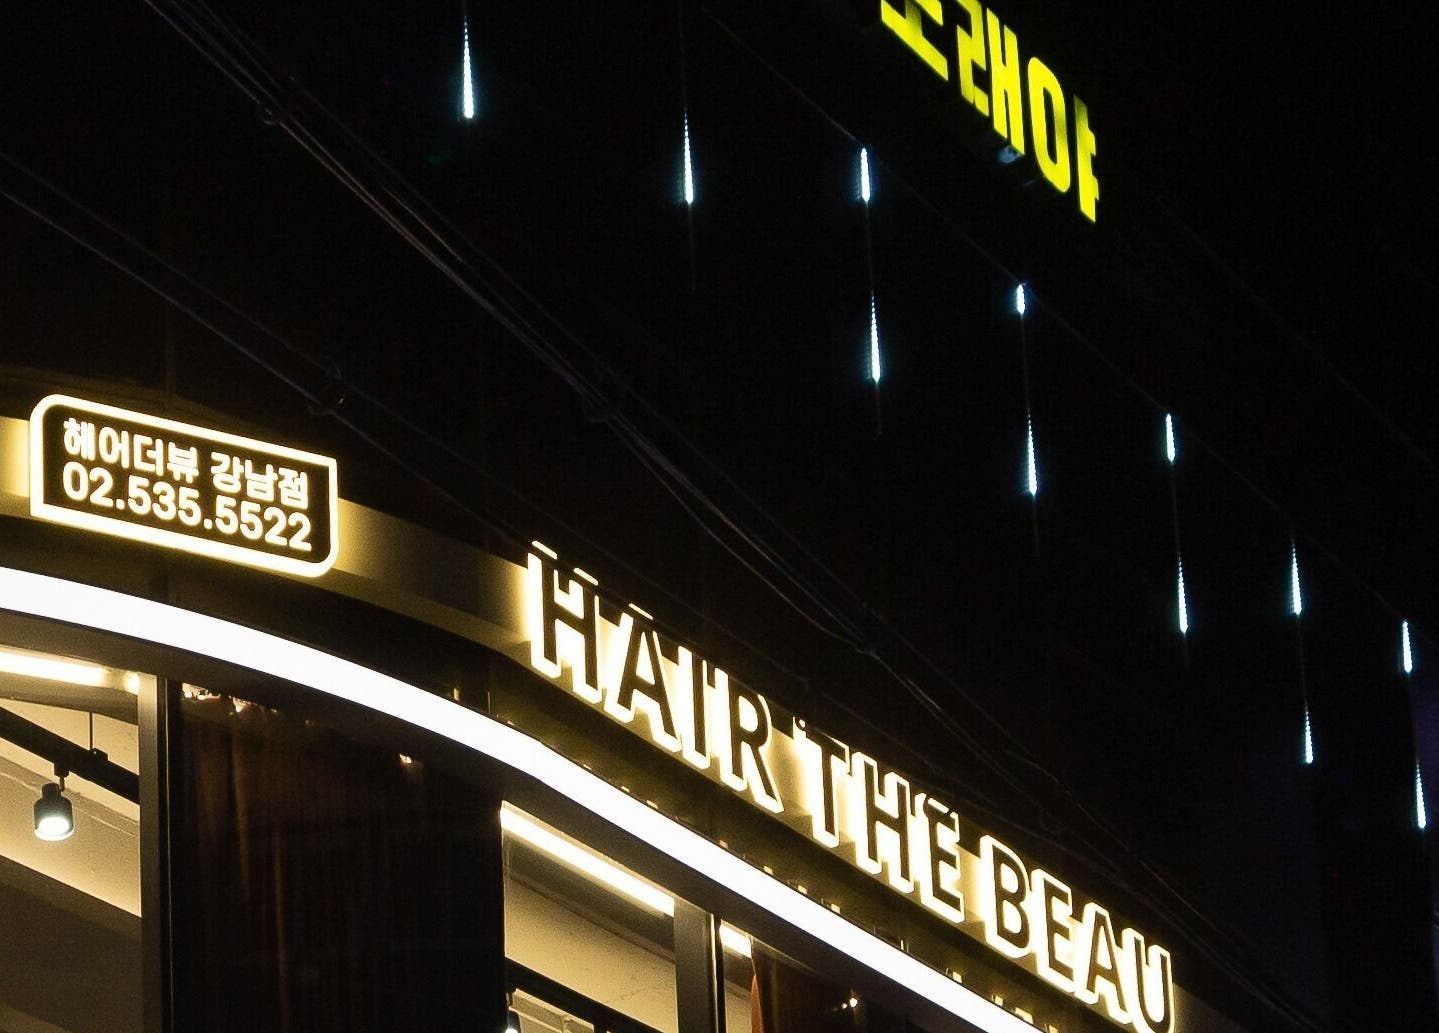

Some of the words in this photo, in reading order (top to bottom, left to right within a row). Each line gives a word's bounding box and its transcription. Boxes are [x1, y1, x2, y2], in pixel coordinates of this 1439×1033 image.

[62, 461, 313, 552] 02.535.5522
[63, 417, 200, 484] 헤어더뷰
[210, 451, 310, 510] 강남점
[526, 540, 785, 814] HAIR
[791, 718, 965, 924] THE
